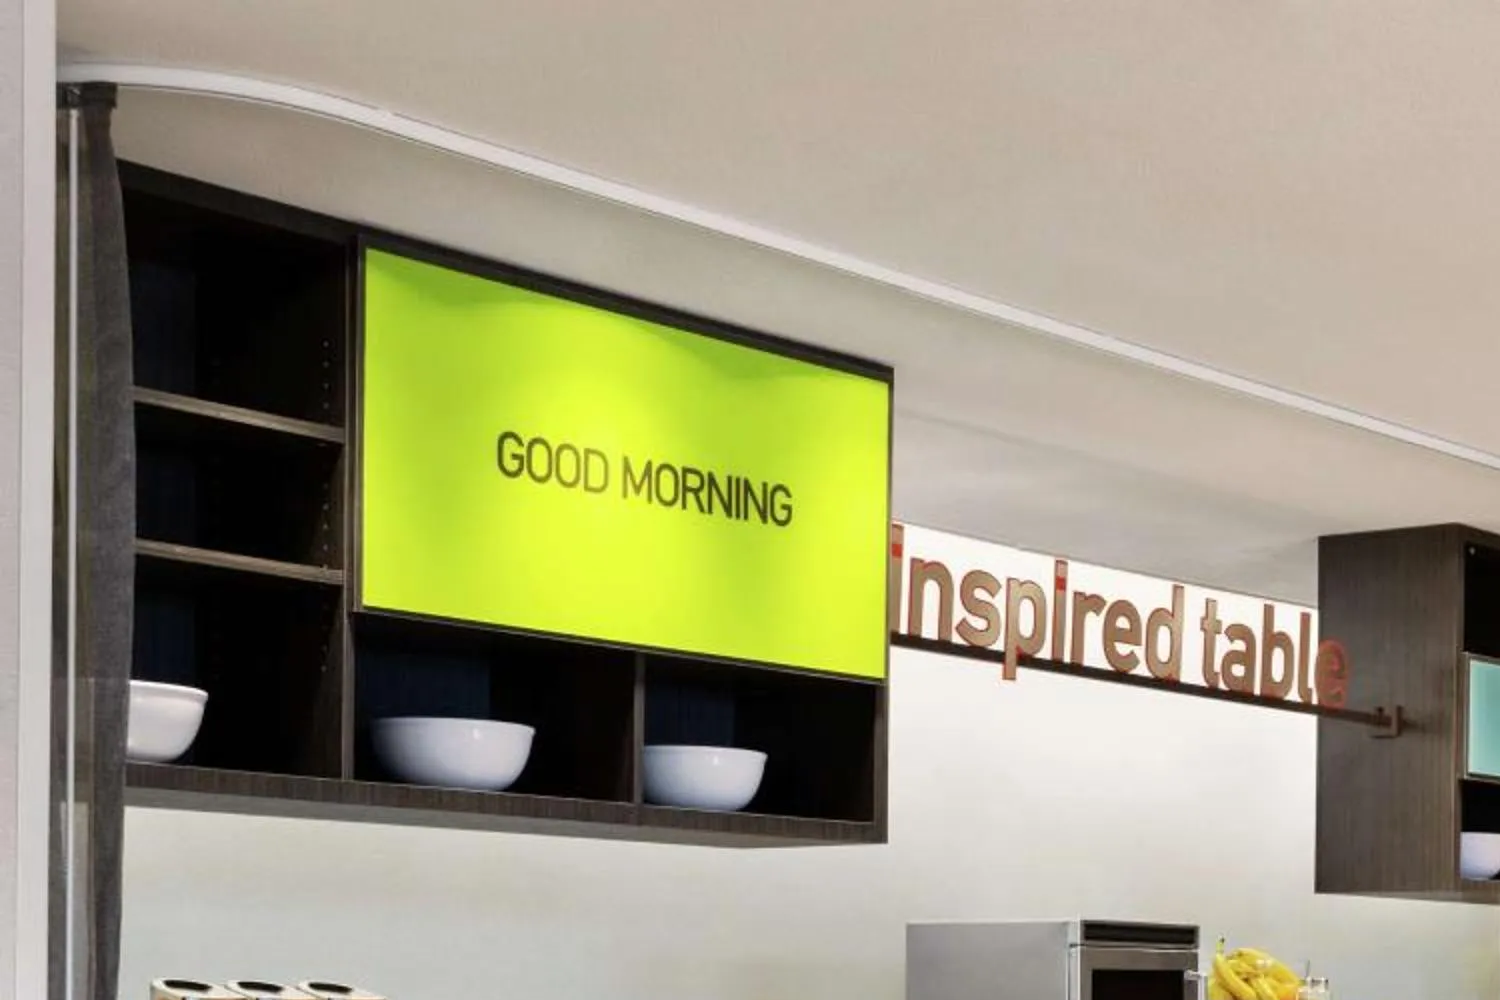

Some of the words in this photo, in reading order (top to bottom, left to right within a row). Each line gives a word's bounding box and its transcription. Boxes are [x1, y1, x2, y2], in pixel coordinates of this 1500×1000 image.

[497, 430, 610, 493] GOOD
[622, 455, 794, 527] MORNING
[891, 522, 1184, 681] inspired
[1200, 597, 1349, 709] table
